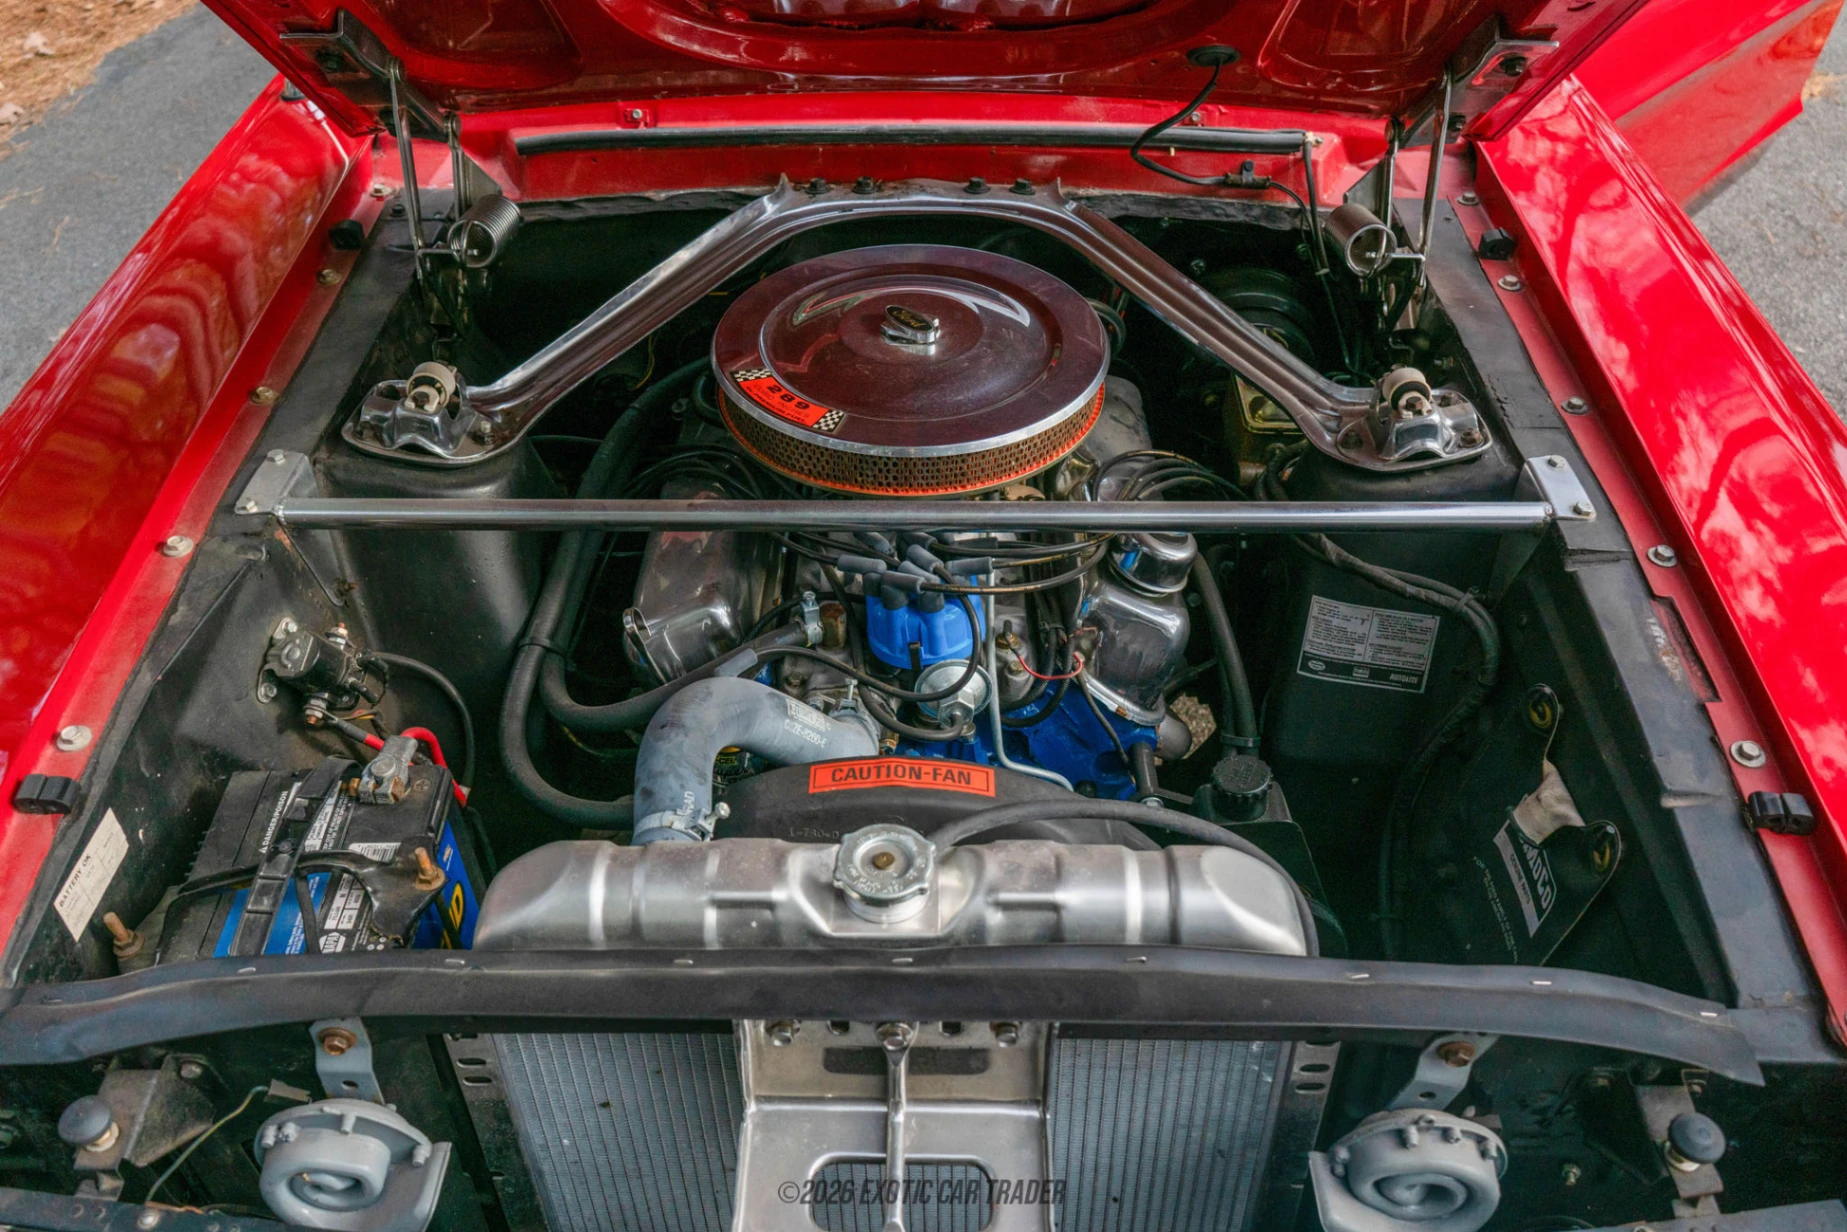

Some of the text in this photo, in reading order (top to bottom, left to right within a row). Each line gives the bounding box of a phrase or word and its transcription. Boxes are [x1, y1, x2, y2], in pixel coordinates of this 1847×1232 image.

[766, 384, 810, 410] 289
[831, 764, 972, 786] CAUTION-FAN
[262, 790, 288, 846] DANGER/POISON
[59, 869, 82, 908] BATTERY
[83, 854, 91, 867] OK
